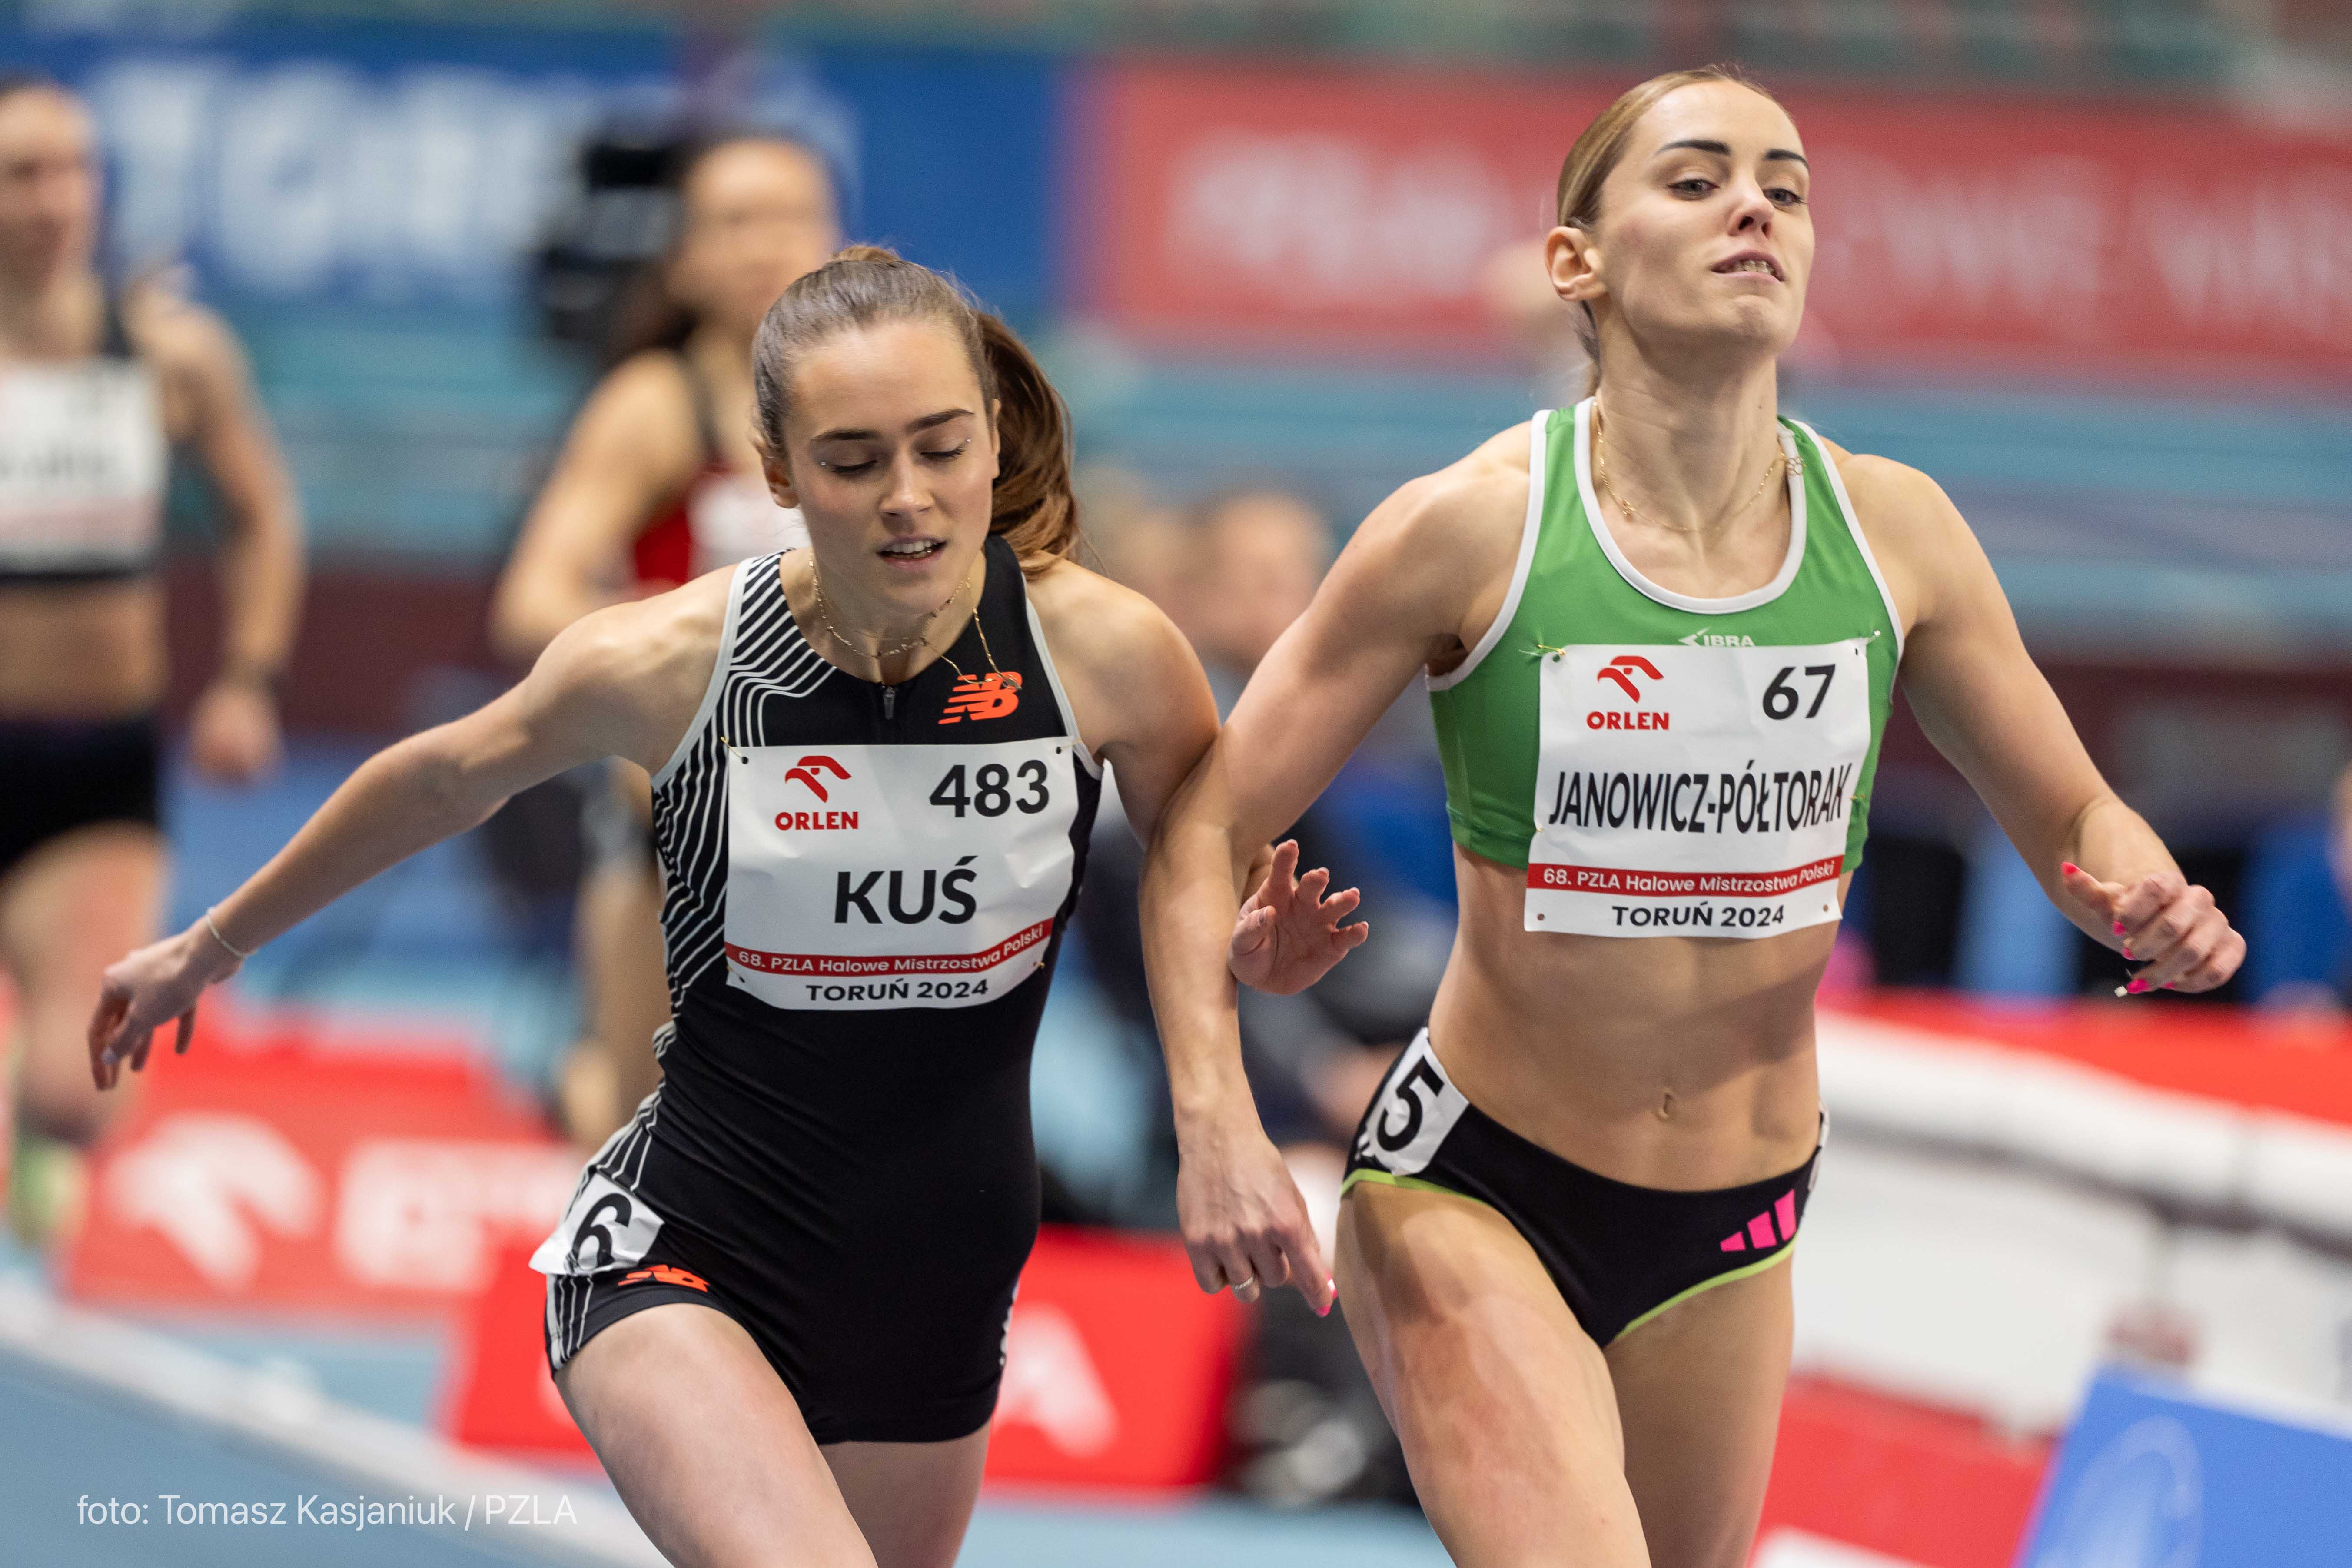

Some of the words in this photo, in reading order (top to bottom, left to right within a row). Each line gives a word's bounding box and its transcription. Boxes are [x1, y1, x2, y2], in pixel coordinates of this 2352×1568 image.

[1762, 664, 1836, 721] 67
[1586, 711, 1670, 731] ORLEN
[929, 759, 1050, 818] 483
[1548, 759, 1853, 834] JANOWICZ-PÓŁTORAK
[775, 811, 859, 831] ORLEN
[834, 855, 978, 924] KUŚ
[1543, 868, 1571, 885] 68.
[1577, 871, 1621, 889] PZLA
[1626, 875, 1695, 891] Halowe
[1699, 874, 1797, 892] Mistrzostwa
[1799, 860, 1835, 884] Polski
[1612, 900, 1713, 927] TORUŃ
[1721, 904, 1784, 927] 2024
[739, 951, 765, 967] 68.
[771, 957, 814, 971] PZLA
[820, 960, 889, 972] Halowe
[894, 950, 1000, 970] Mistrzostwa
[1003, 924, 1043, 957] Polski
[806, 978, 909, 1001] TORUŃ
[917, 979, 989, 999] 2024
[1377, 1054, 1445, 1153] 5
[570, 1193, 632, 1271] 6
